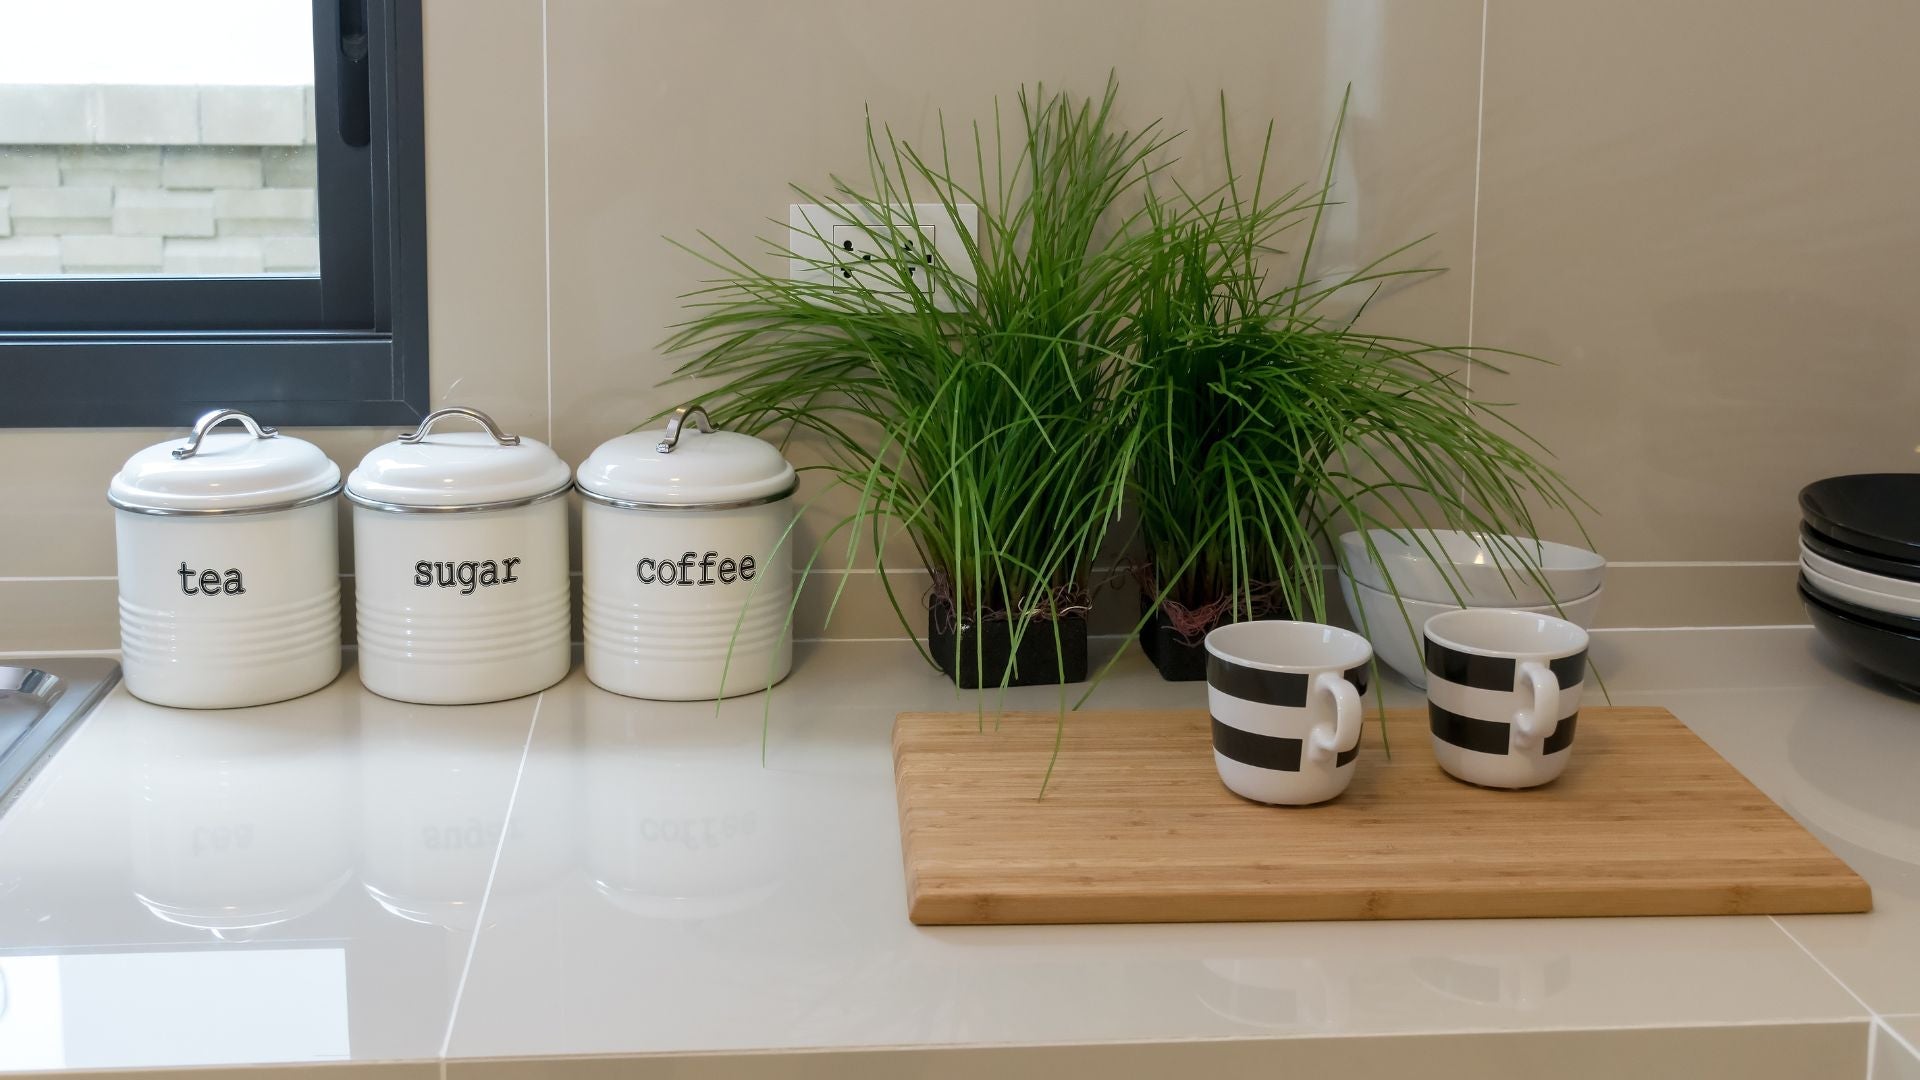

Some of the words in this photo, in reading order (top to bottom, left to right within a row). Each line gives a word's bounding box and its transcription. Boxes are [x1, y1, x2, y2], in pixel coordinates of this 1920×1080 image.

[177, 561, 247, 597] tea
[413, 555, 522, 596] sugar
[636, 551, 757, 587] coffee
